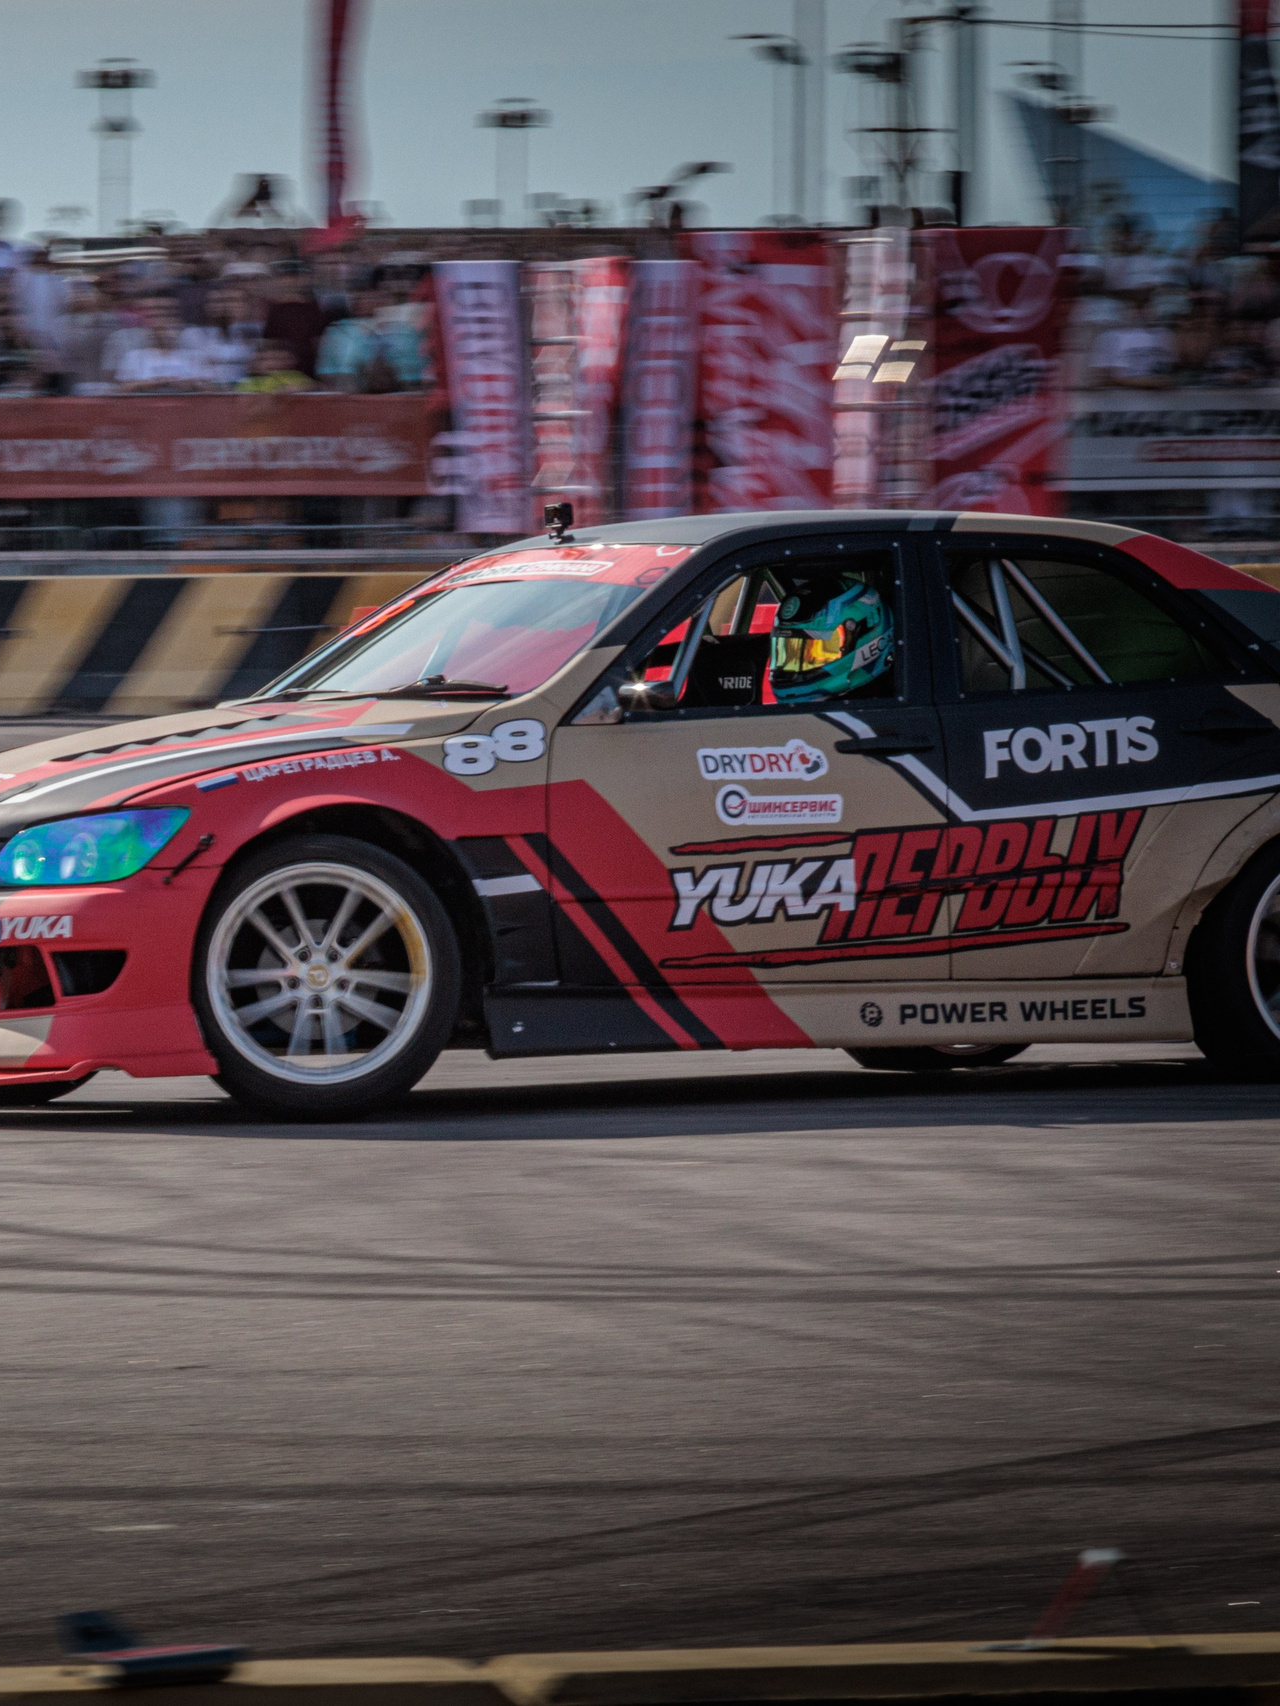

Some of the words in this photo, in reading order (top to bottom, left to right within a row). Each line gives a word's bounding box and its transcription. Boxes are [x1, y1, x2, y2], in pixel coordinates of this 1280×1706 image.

[442, 718, 547, 776] 88
[983, 715, 1160, 779] FORTIS
[241, 751, 376, 783] ЦАРЕГРАДЦЕВ
[701, 753, 794, 774] DRYDRY
[747, 800, 838, 814] ШИНСЕРВИС
[670, 858, 856, 929] YUKA
[0, 915, 74, 940] YUKA
[899, 1001, 1008, 1025] POWER
[1019, 996, 1146, 1022] WHEELS
